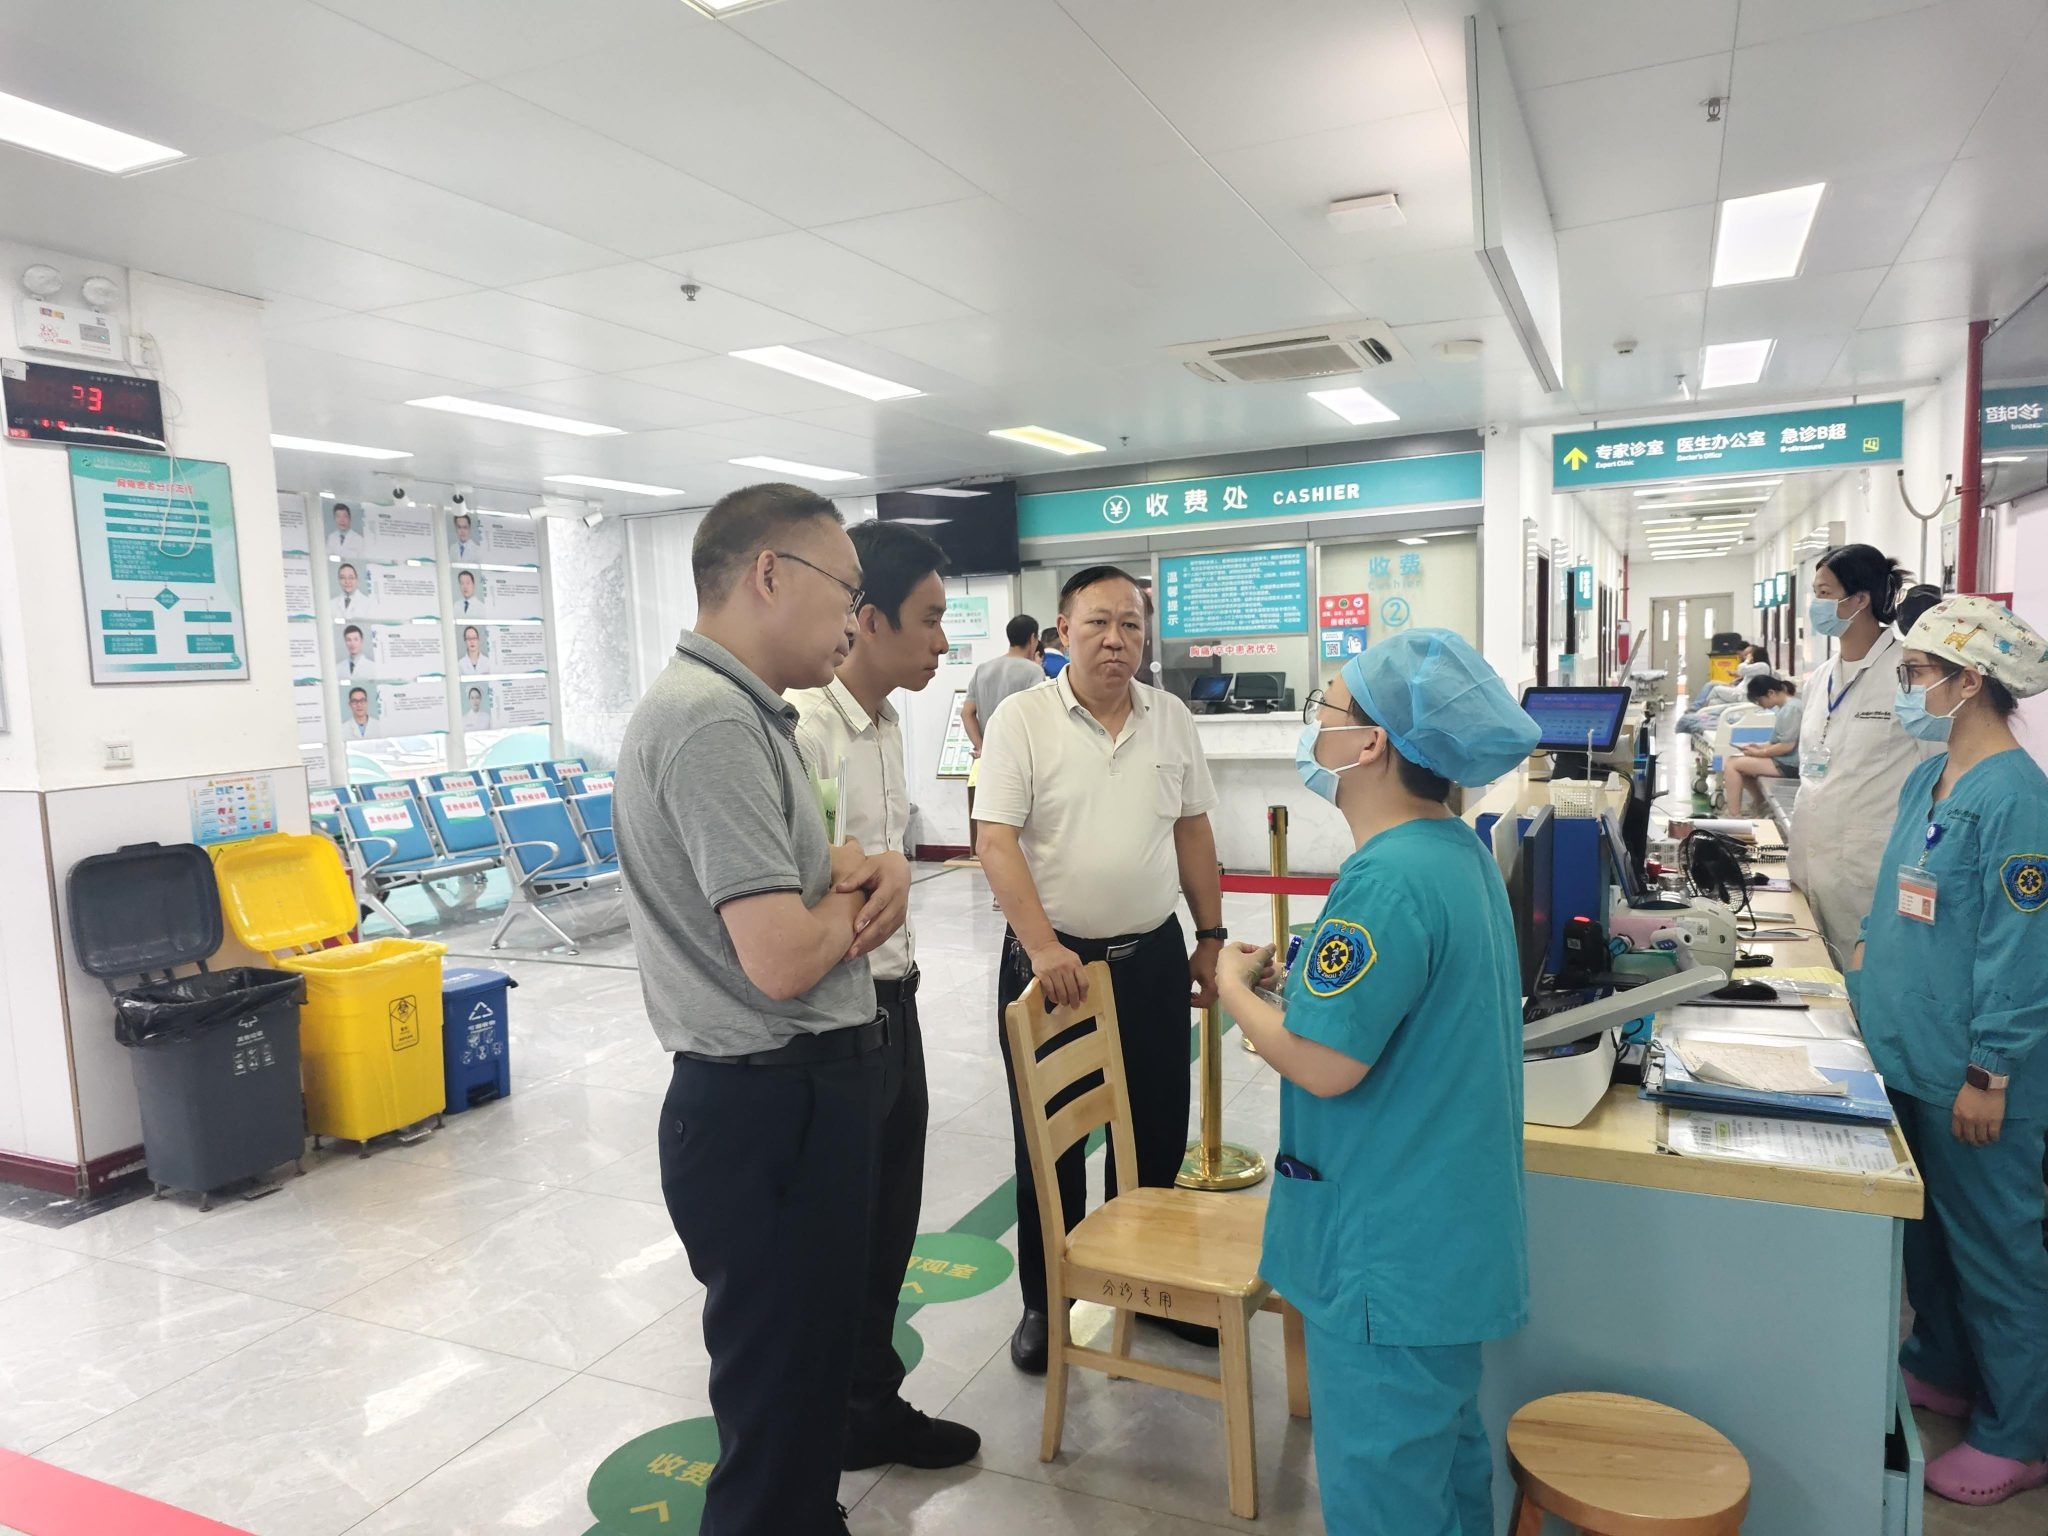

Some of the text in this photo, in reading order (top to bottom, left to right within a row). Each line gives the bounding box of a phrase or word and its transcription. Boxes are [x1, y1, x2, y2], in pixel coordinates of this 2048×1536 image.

[1595, 423, 1847, 459] 专家诊室 医生办公室 急诊B超
[1595, 460, 1616, 469] Expert
[1617, 459, 1635, 467] Clinic
[1704, 452, 1723, 460] Office
[1145, 485, 1248, 517] 收费处
[1273, 483, 1360, 505] CASHIER
[1369, 553, 1420, 577] 收费
[1167, 571, 1179, 626] 温馨提示
[1334, 923, 1356, 935] 120
[1102, 1279, 1171, 1318] 分诊专用
